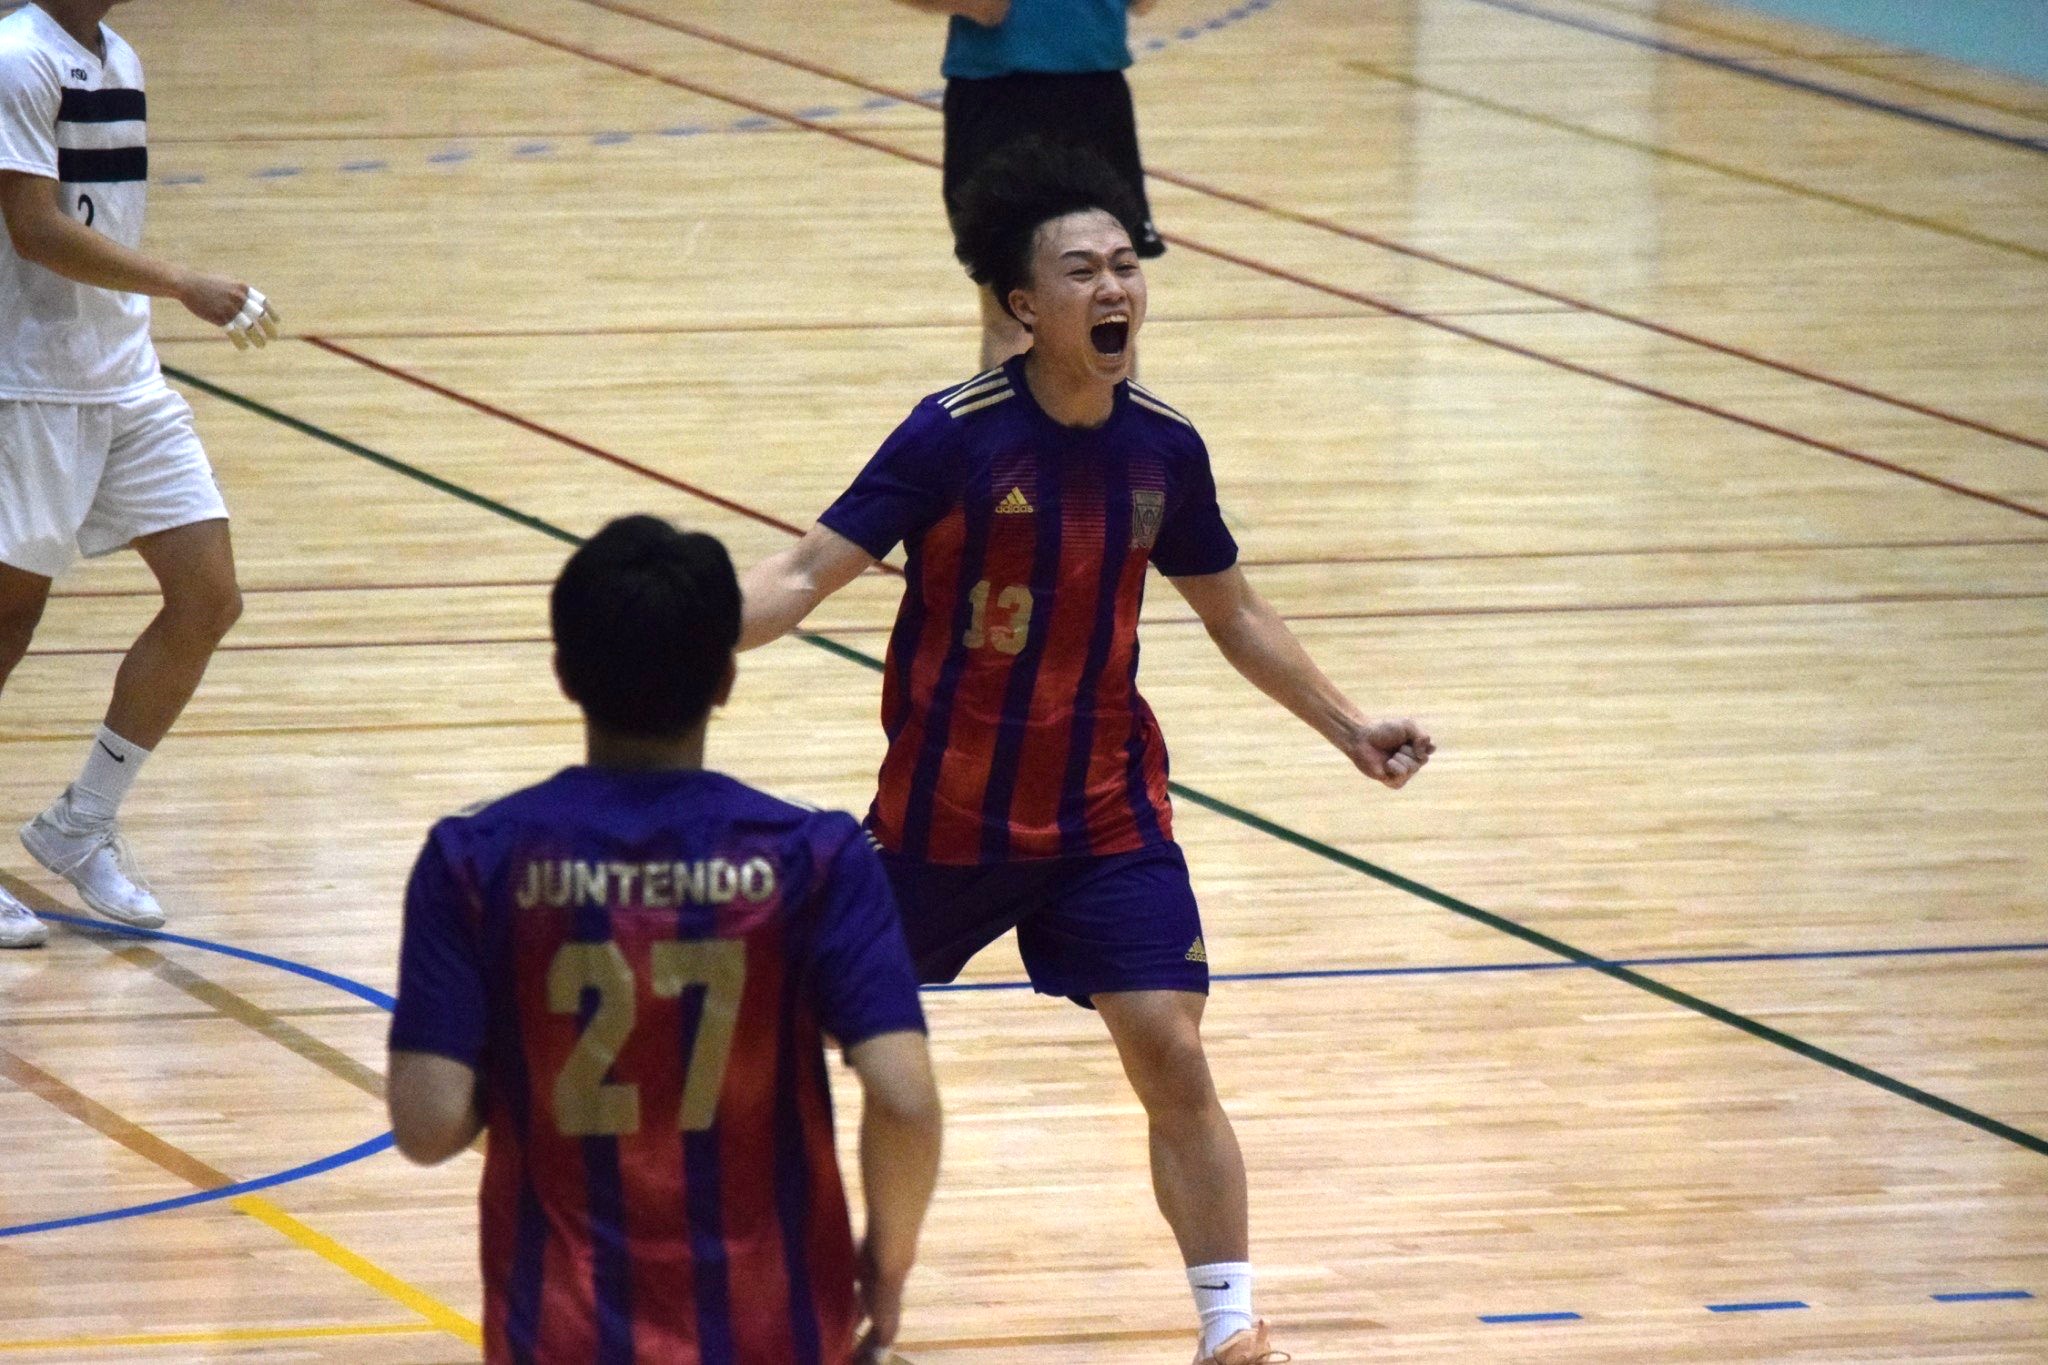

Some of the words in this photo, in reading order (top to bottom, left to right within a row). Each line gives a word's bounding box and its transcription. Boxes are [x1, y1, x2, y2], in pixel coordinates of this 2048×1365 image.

[995, 503, 1034, 514] adidas
[962, 579, 1034, 655] 13
[516, 857, 776, 910] JUNTENDO
[546, 938, 747, 1136] 27
